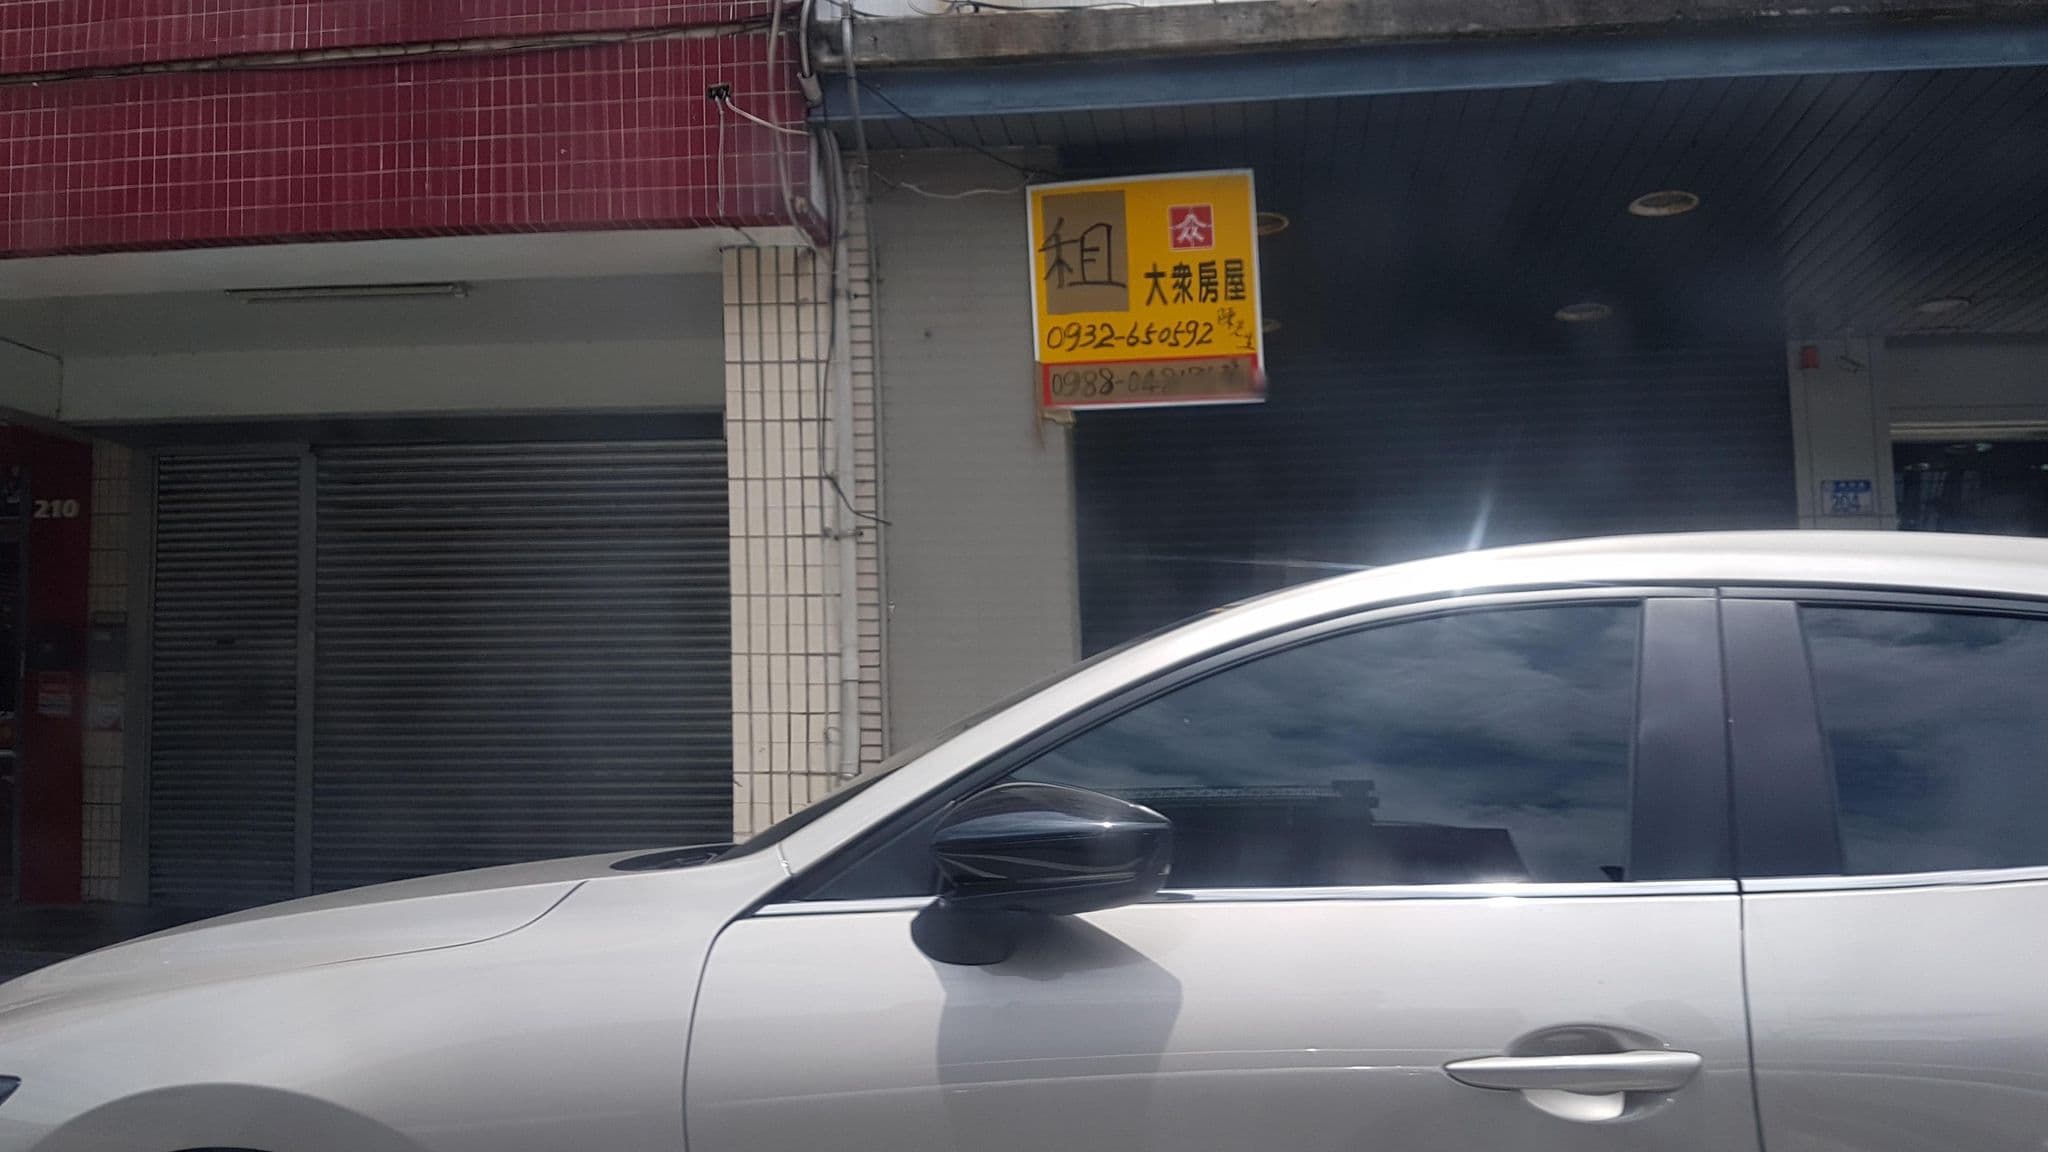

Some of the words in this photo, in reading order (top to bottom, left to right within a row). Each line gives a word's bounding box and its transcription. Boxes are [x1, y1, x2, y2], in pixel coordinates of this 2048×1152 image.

[1038, 217, 1126, 288] 租
[1047, 321, 1213, 352] 0932-650592
[1052, 362, 1214, 396] 0988-04
[33, 498, 80, 518] 210
